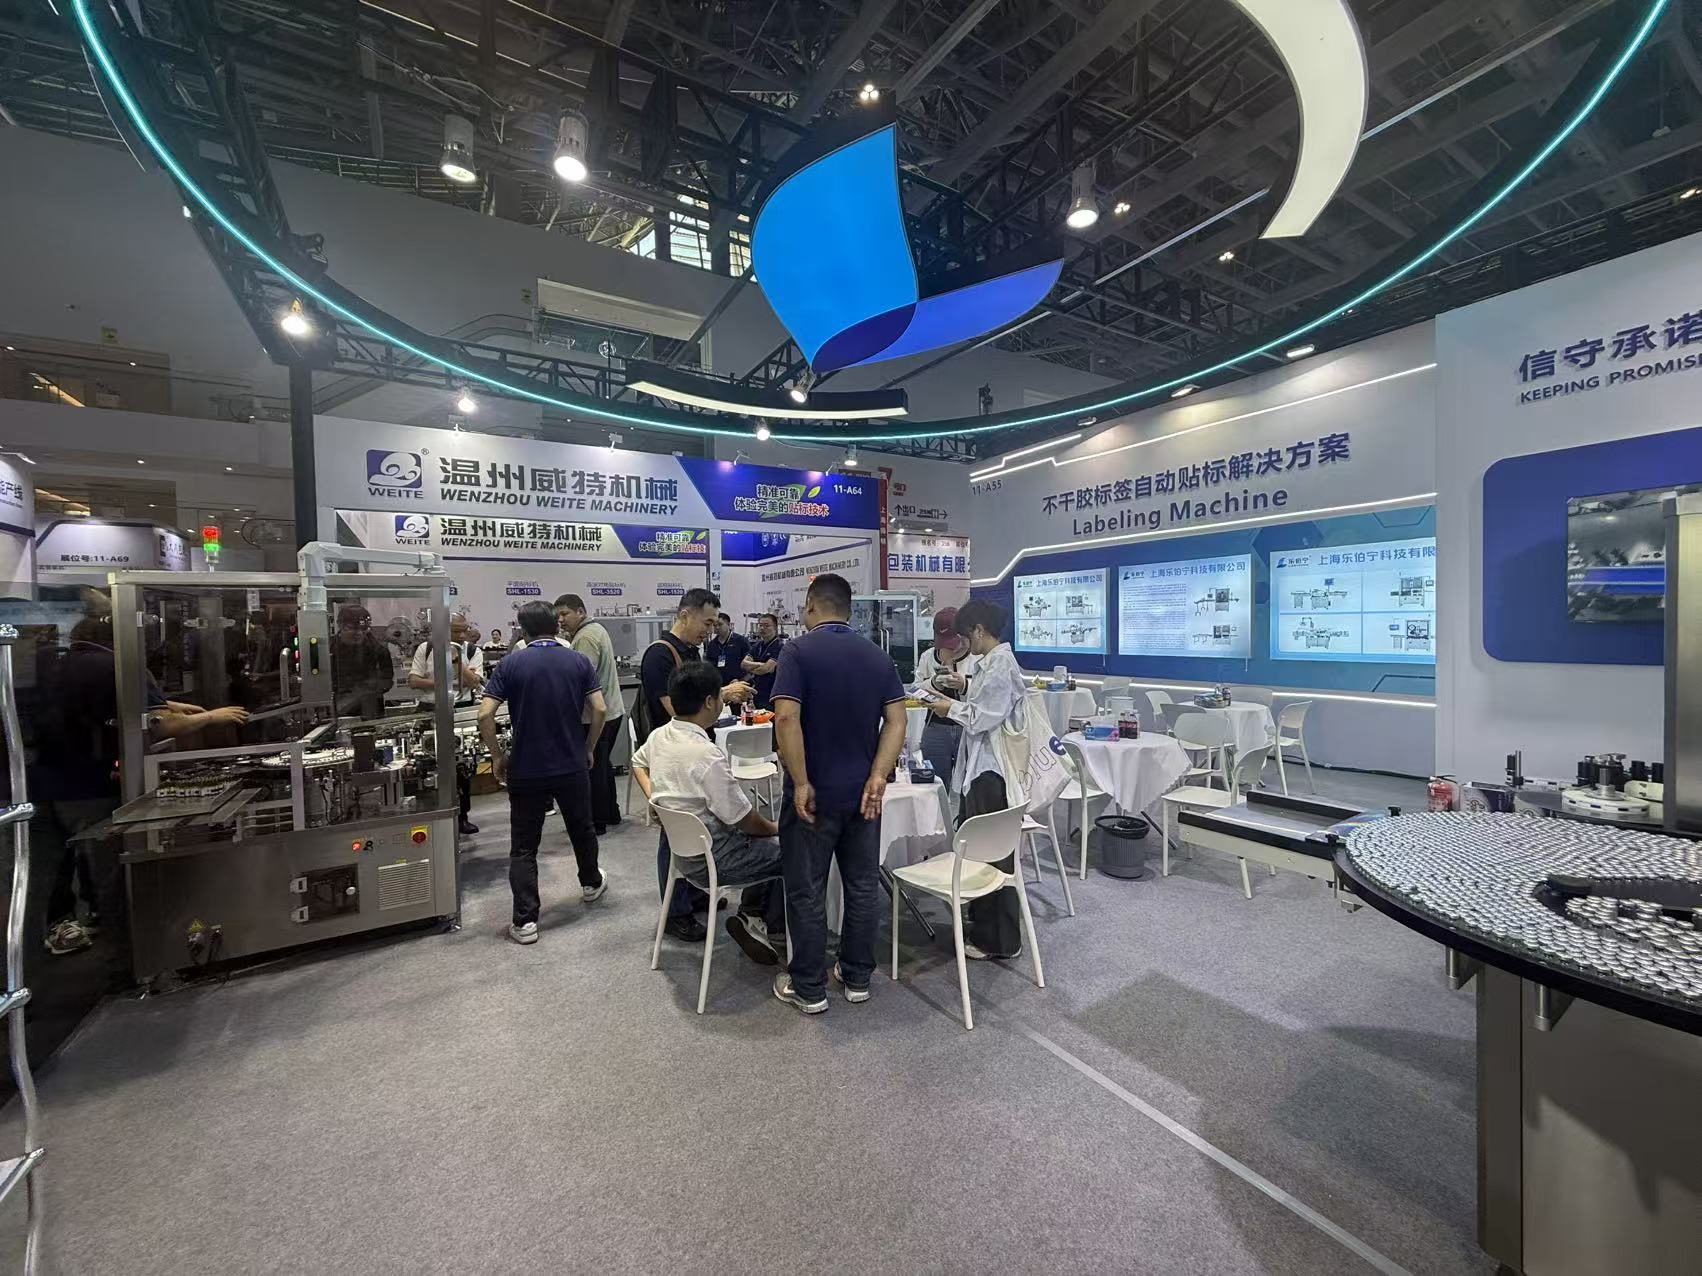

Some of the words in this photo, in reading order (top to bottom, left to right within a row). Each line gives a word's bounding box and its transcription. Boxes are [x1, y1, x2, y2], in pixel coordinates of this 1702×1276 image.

[1518, 310, 1702, 383] 信守承诺
[1520, 375, 1600, 403] KEEPING
[1609, 352, 1702, 385] PROMIS
[439, 456, 678, 502] 温州威特机械
[1042, 432, 1350, 515] 不干胶标签自动贴标解决方案
[368, 487, 424, 499] WEITE
[756, 484, 801, 500] 精准可靠
[833, 484, 863, 496] 11-A64
[972, 480, 1002, 495] 11-A55
[440, 488, 531, 506] WENZHOU
[536, 495, 586, 510] WEITE
[590, 499, 678, 516] MACHINERY
[734, 496, 830, 518] 体验完美的贴标技术
[1073, 508, 1161, 536] Labeling
[1169, 489, 1288, 522] Machine
[440, 517, 602, 542] 温州威特机械
[395, 538, 431, 546] WEITE
[440, 537, 500, 548] WENZHOU
[503, 540, 538, 549] WEITE
[540, 541, 602, 552] MACHINERY
[888, 552, 970, 573] 包装机械有限
[1150, 561, 1246, 578] 上海乐伯宁科技有限公司
